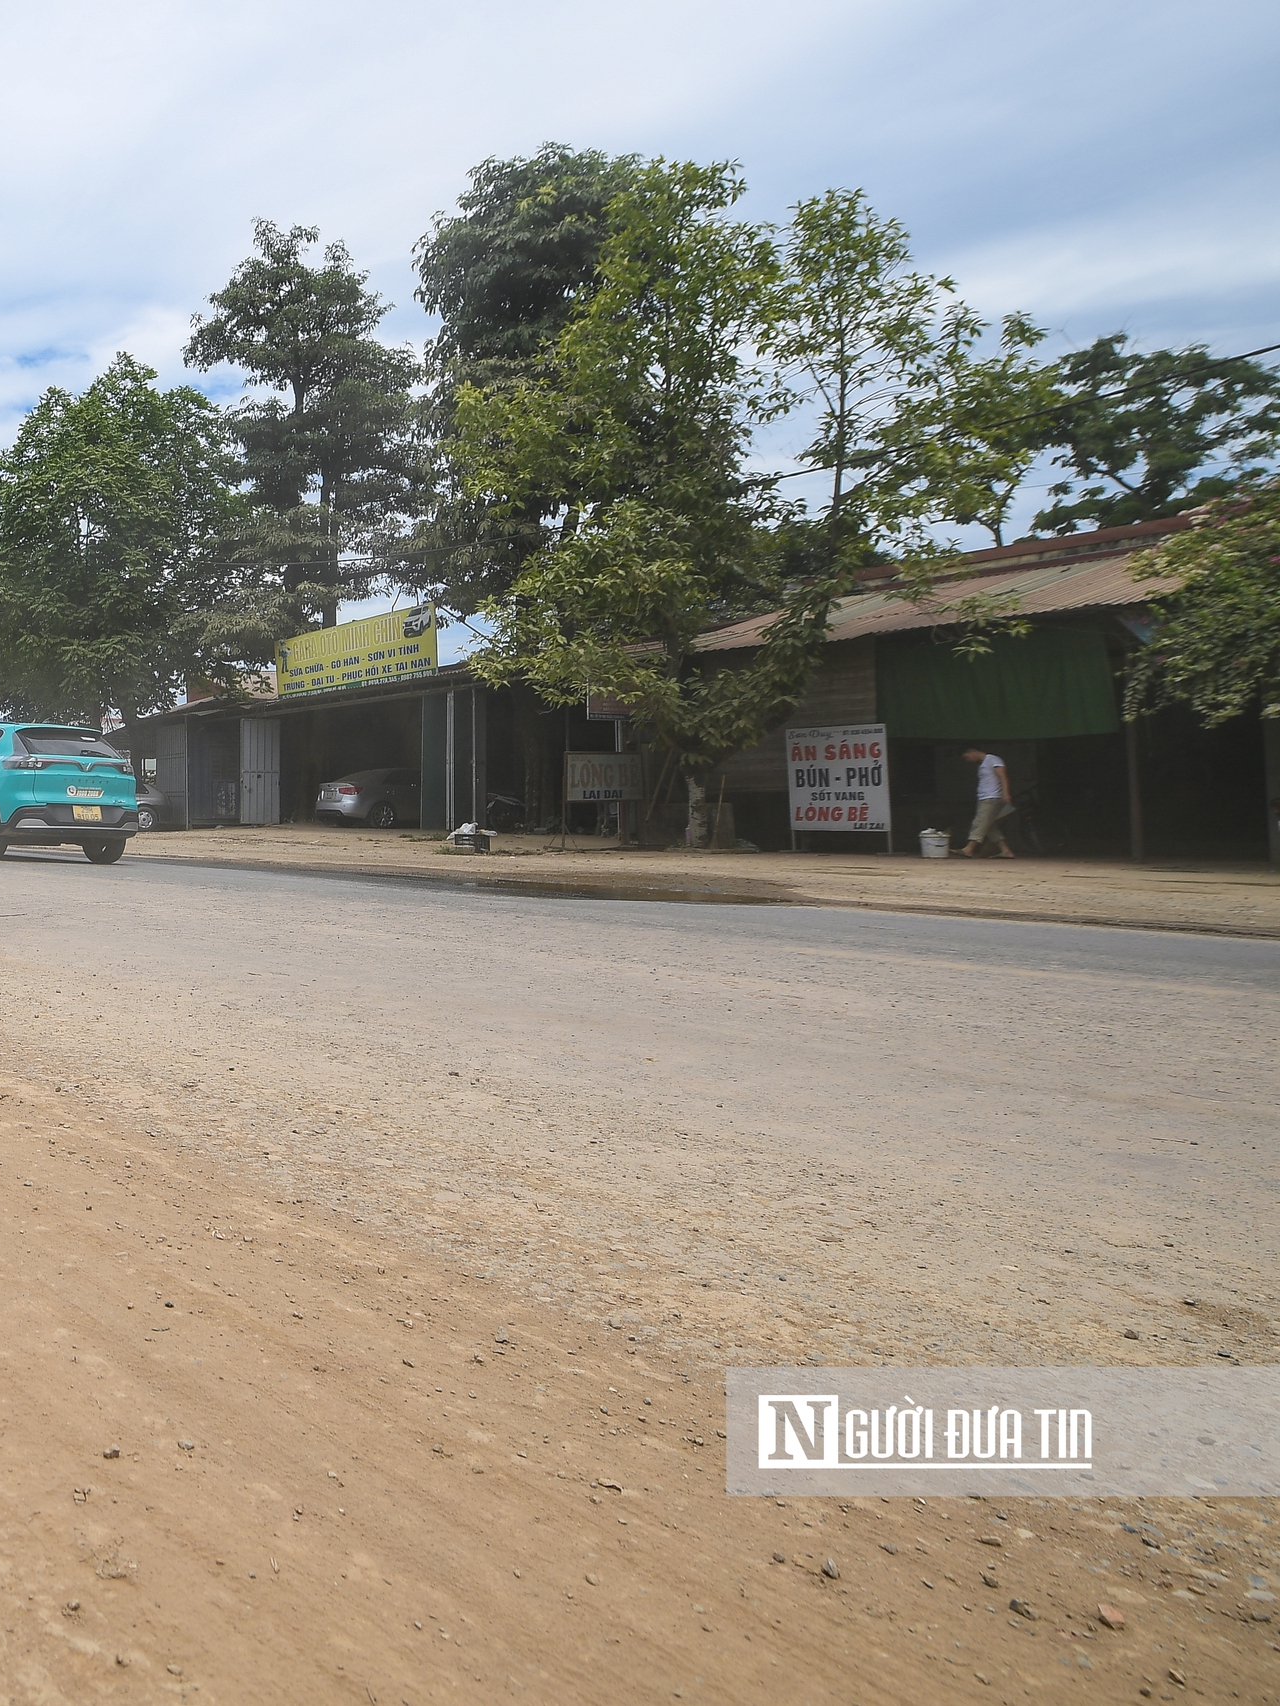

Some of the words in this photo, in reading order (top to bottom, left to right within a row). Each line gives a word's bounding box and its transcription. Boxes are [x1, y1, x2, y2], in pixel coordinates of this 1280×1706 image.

[292, 636, 319, 663] GARA
[341, 622, 370, 653] MINH
[367, 650, 385, 661] SƠN
[387, 648, 395, 658] VI
[398, 643, 419, 656] TÍNH
[311, 677, 324, 687] ĐẠI
[342, 670, 362, 682] PHỤC
[381, 664, 392, 674] XE
[395, 661, 408, 672] TAI
[411, 657, 431, 670] NẠN
[791, 742, 817, 761] ĂN
[824, 739, 882, 760] SÁNG
[795, 764, 830, 788] BÚN
[846, 760, 882, 787] PHỞ
[583, 790, 600, 799] LAI
[604, 789, 623, 799] DAI
[835, 791, 865, 801] VANG
[795, 802, 843, 822] LÒNG
[848, 802, 869, 822] BÊ
